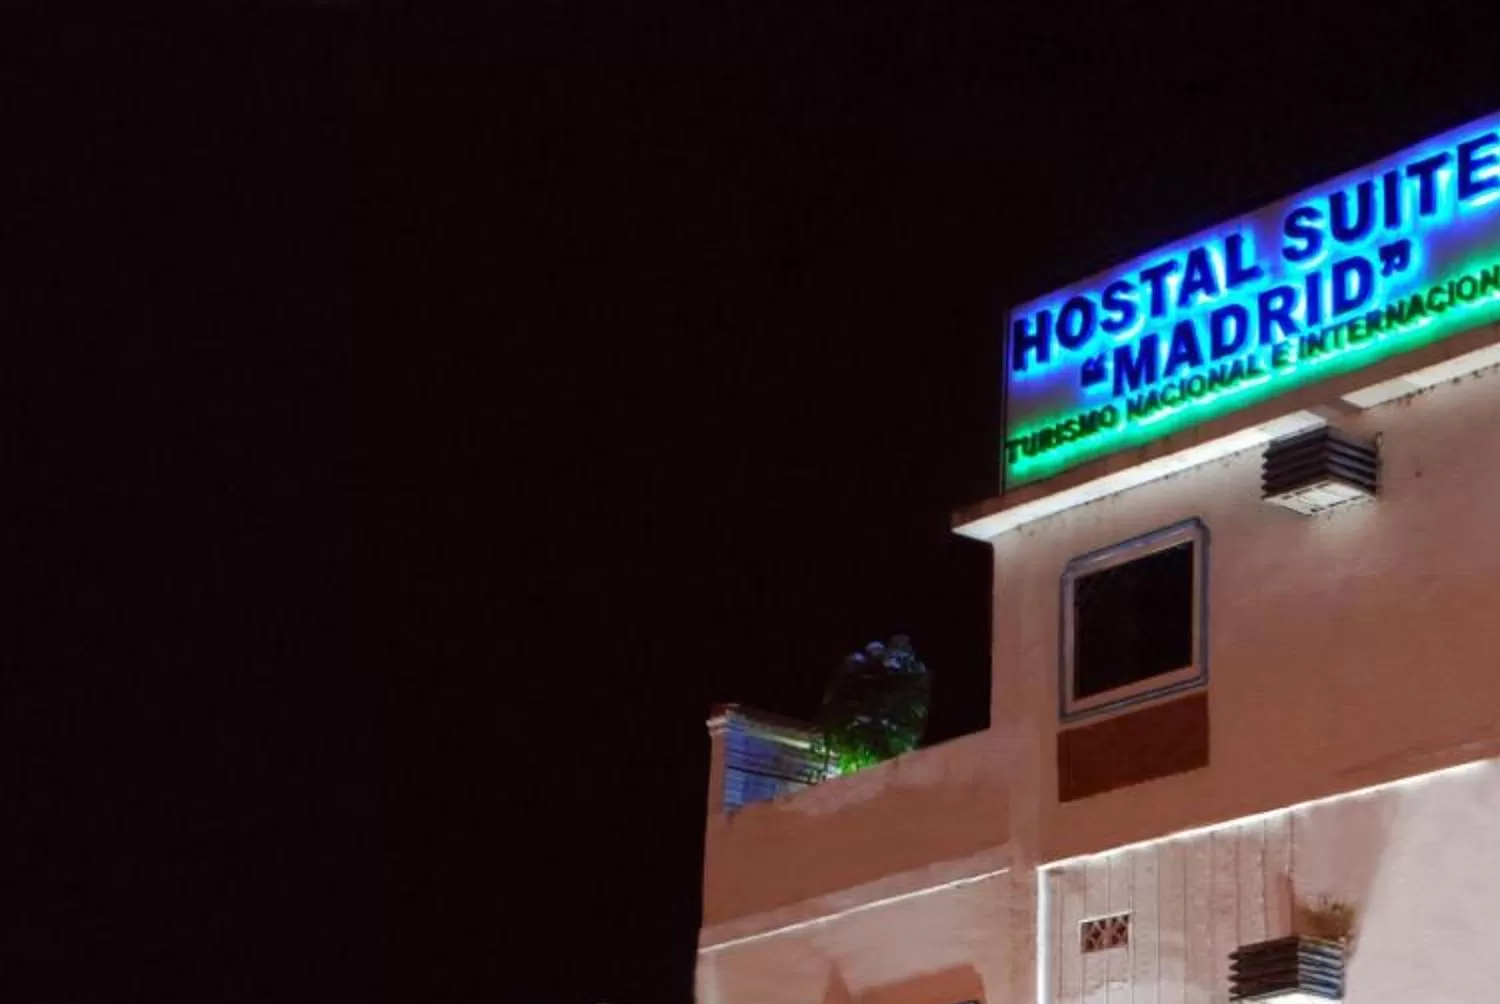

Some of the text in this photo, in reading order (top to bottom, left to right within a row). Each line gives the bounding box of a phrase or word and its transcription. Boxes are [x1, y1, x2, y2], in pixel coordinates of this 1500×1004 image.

[1012, 132, 1500, 372] HOSTAL SUITE
[1006, 405, 1117, 464] TURISMO
[1126, 355, 1263, 422] NACIONAL
[1272, 341, 1290, 369] E
